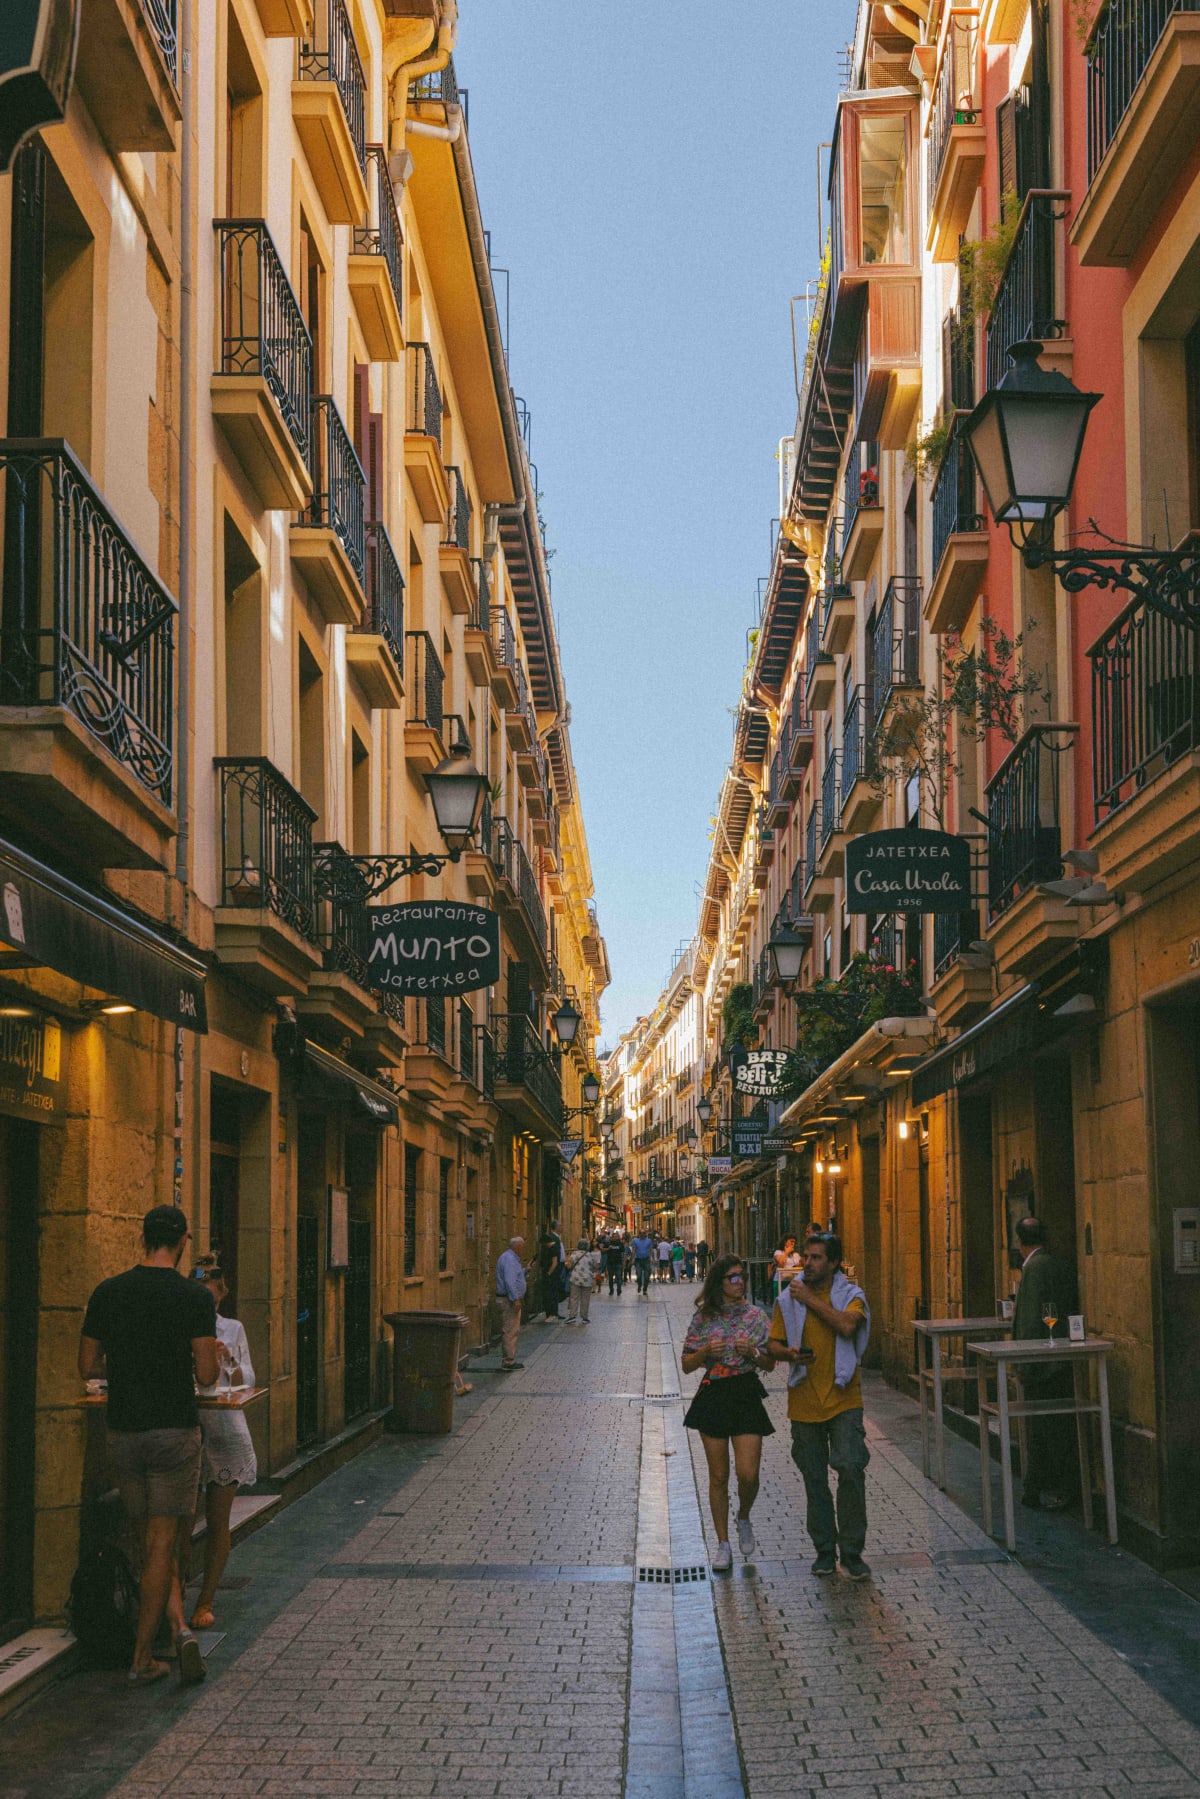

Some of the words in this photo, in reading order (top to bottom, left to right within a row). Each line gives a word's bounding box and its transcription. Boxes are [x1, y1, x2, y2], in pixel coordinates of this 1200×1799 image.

[866, 846, 951, 858] JATETXEA
[854, 869, 904, 894] Casa
[905, 869, 963, 891] Urola
[897, 898, 923, 906] 1956
[371, 905, 488, 931] Restaurante
[368, 931, 491, 966] Munto
[380, 967, 480, 990] Jatetxea
[179, 989, 197, 1017] BAR
[747, 1051, 788, 1065] BAR
